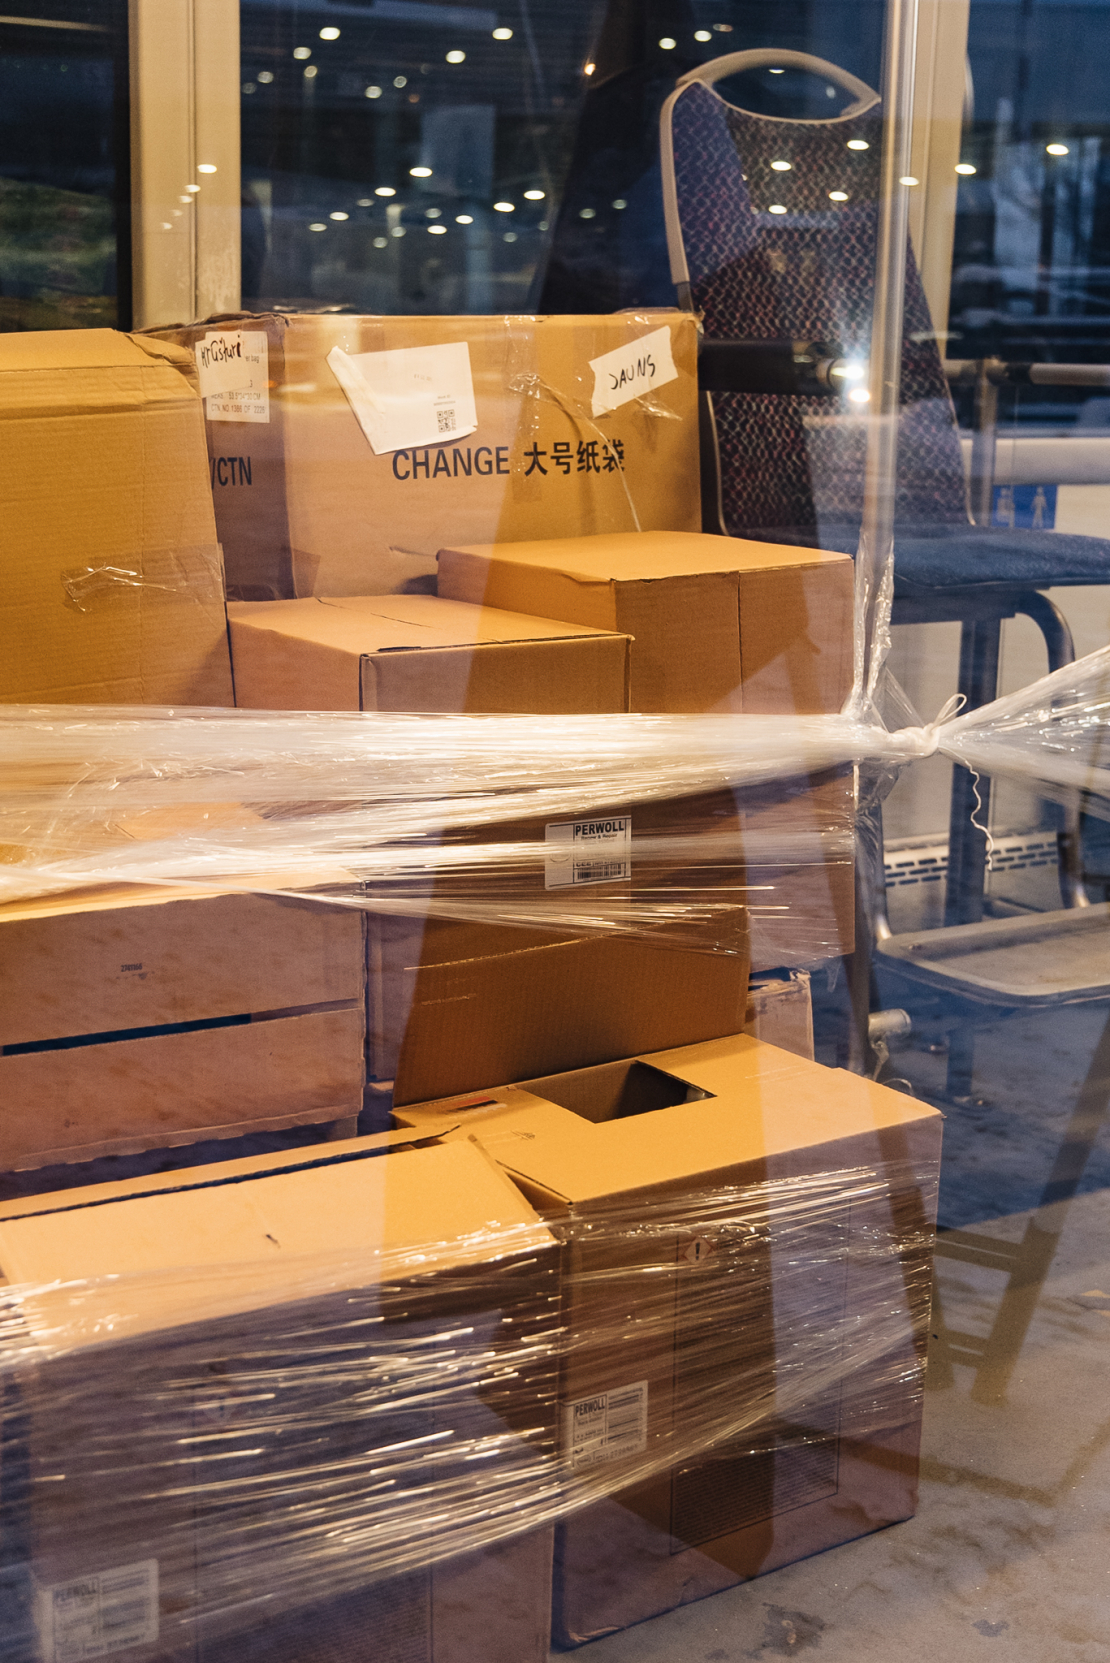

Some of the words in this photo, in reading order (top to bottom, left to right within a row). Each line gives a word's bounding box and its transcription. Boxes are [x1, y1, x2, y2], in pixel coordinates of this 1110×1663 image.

[608, 354, 656, 390] JAUNS
[392, 446, 510, 480] CHANGE
[523, 439, 625, 477] 大号纸袋
[575, 821, 625, 836] PERWOLL
[575, 1398, 605, 1417] PERWOLL
